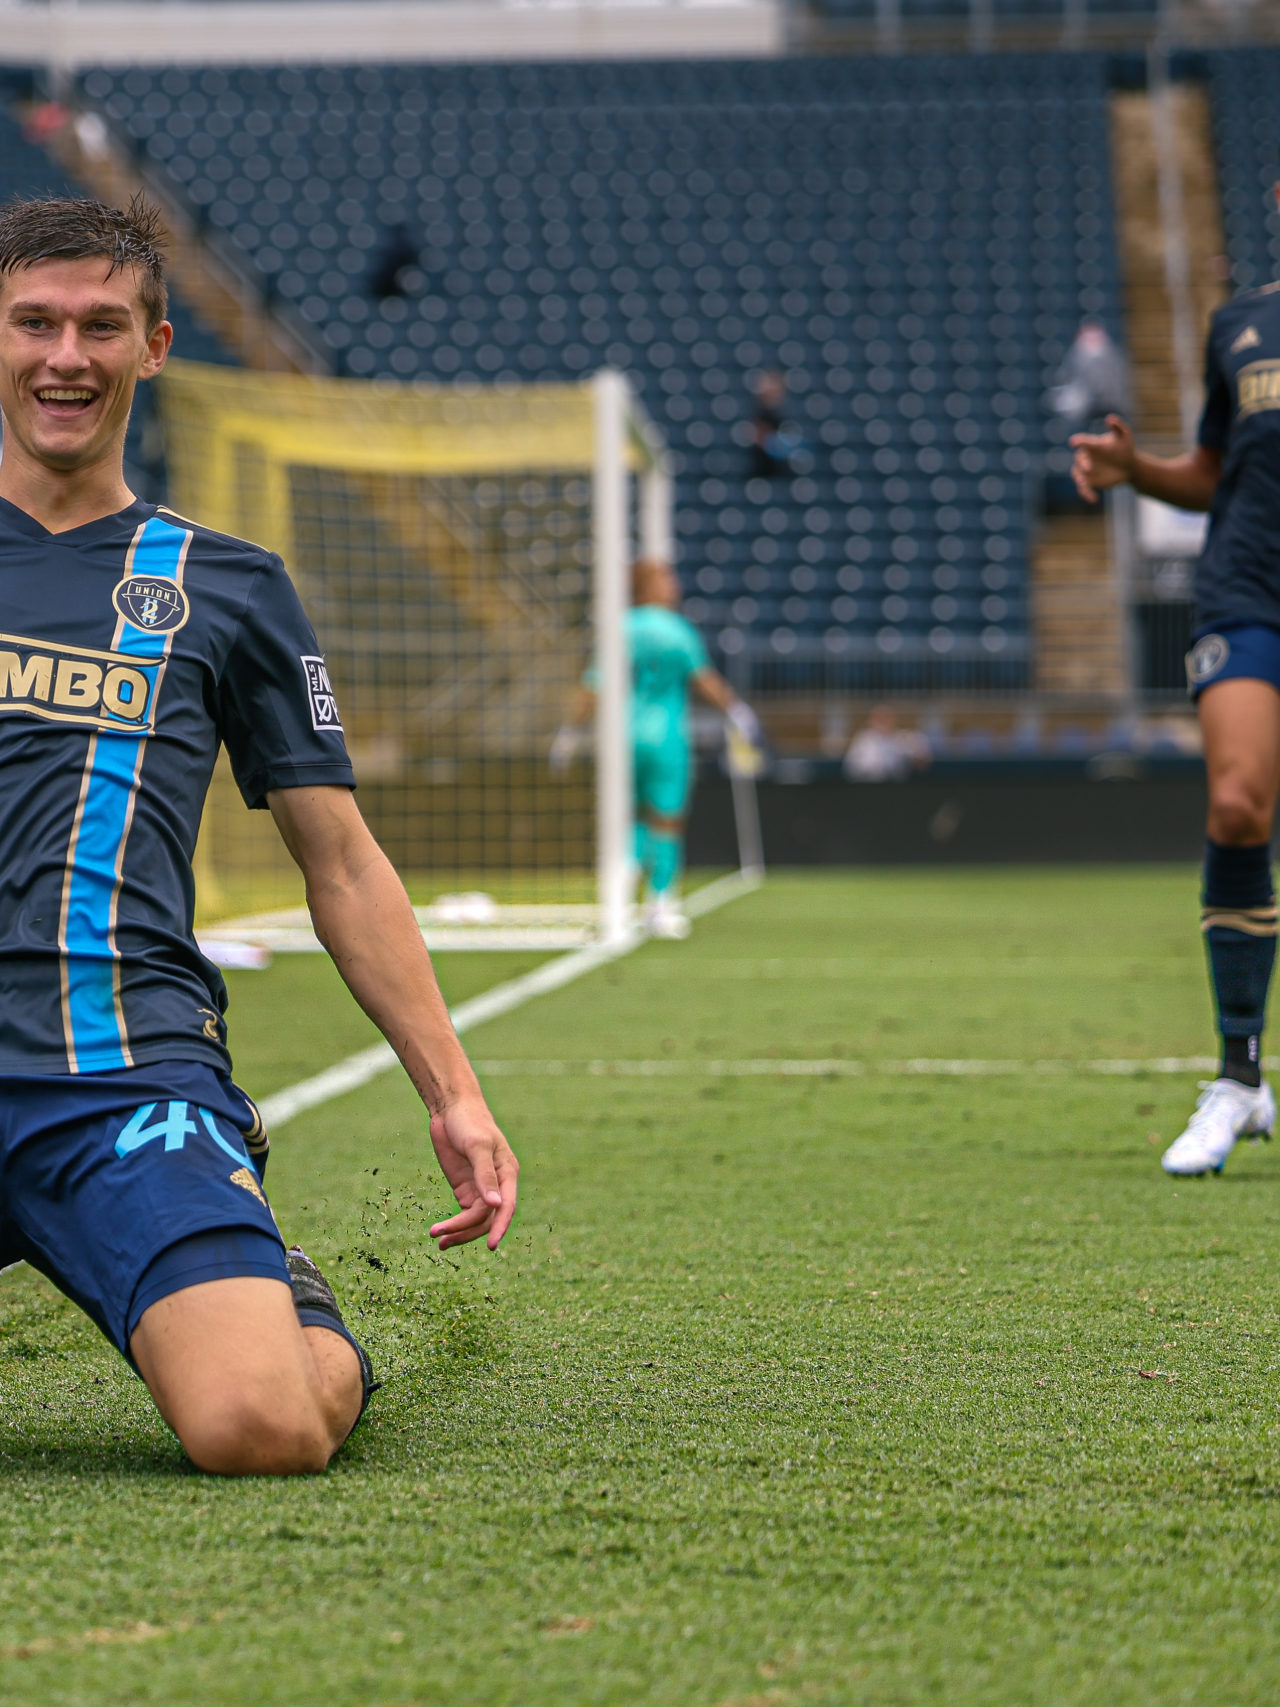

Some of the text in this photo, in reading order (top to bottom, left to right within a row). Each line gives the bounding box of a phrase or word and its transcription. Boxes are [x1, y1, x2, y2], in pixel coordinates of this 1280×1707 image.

[135, 585, 171, 601] UNION
[140, 601, 159, 620] 2
[308, 664, 320, 692] MLS
